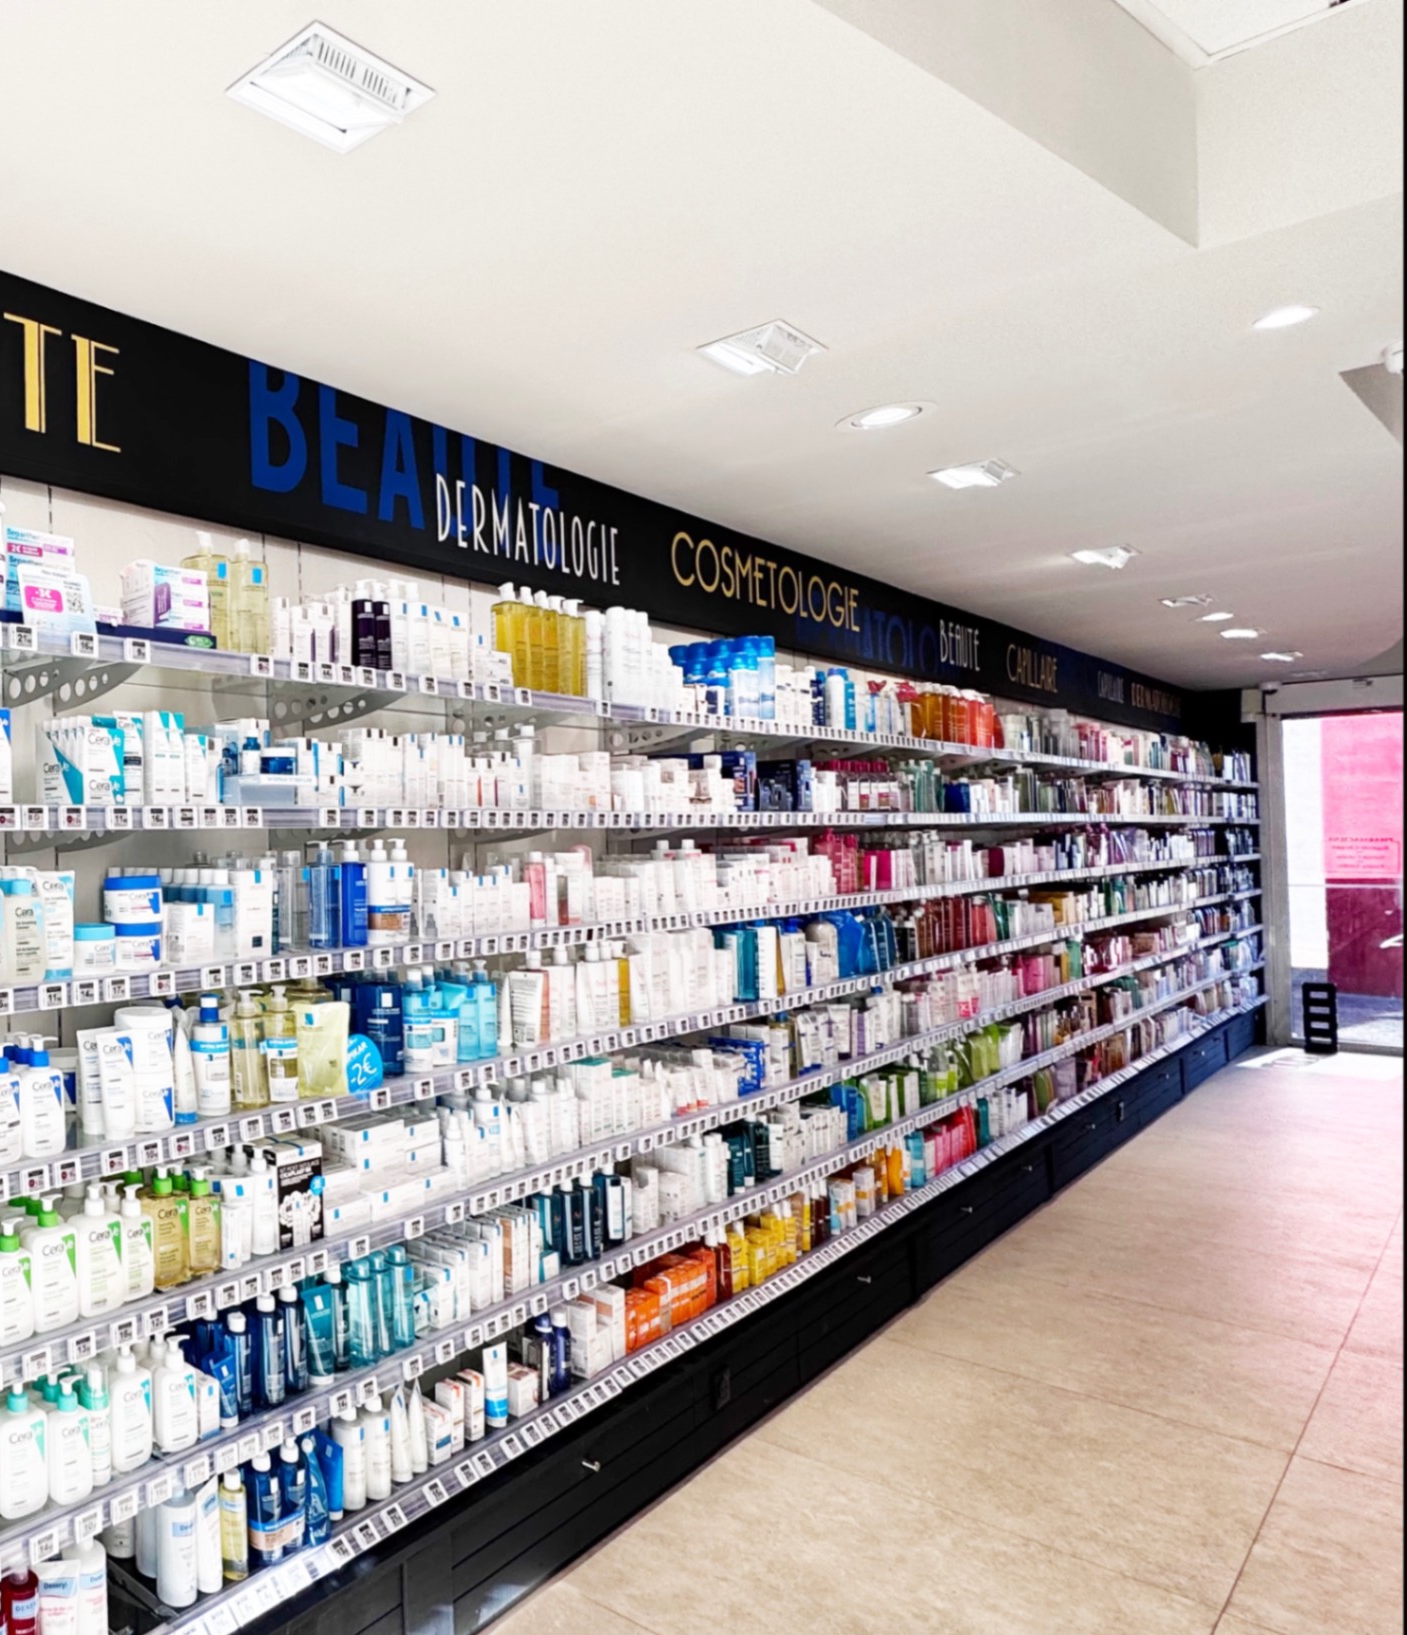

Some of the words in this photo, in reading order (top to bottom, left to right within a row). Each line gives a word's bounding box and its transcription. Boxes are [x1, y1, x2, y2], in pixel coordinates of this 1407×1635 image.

[435, 473, 620, 585] DERMATOLOGIE
[671, 531, 860, 632] COSMETOLOGIE
[1006, 644, 1058, 694] CAPILLAIRE
